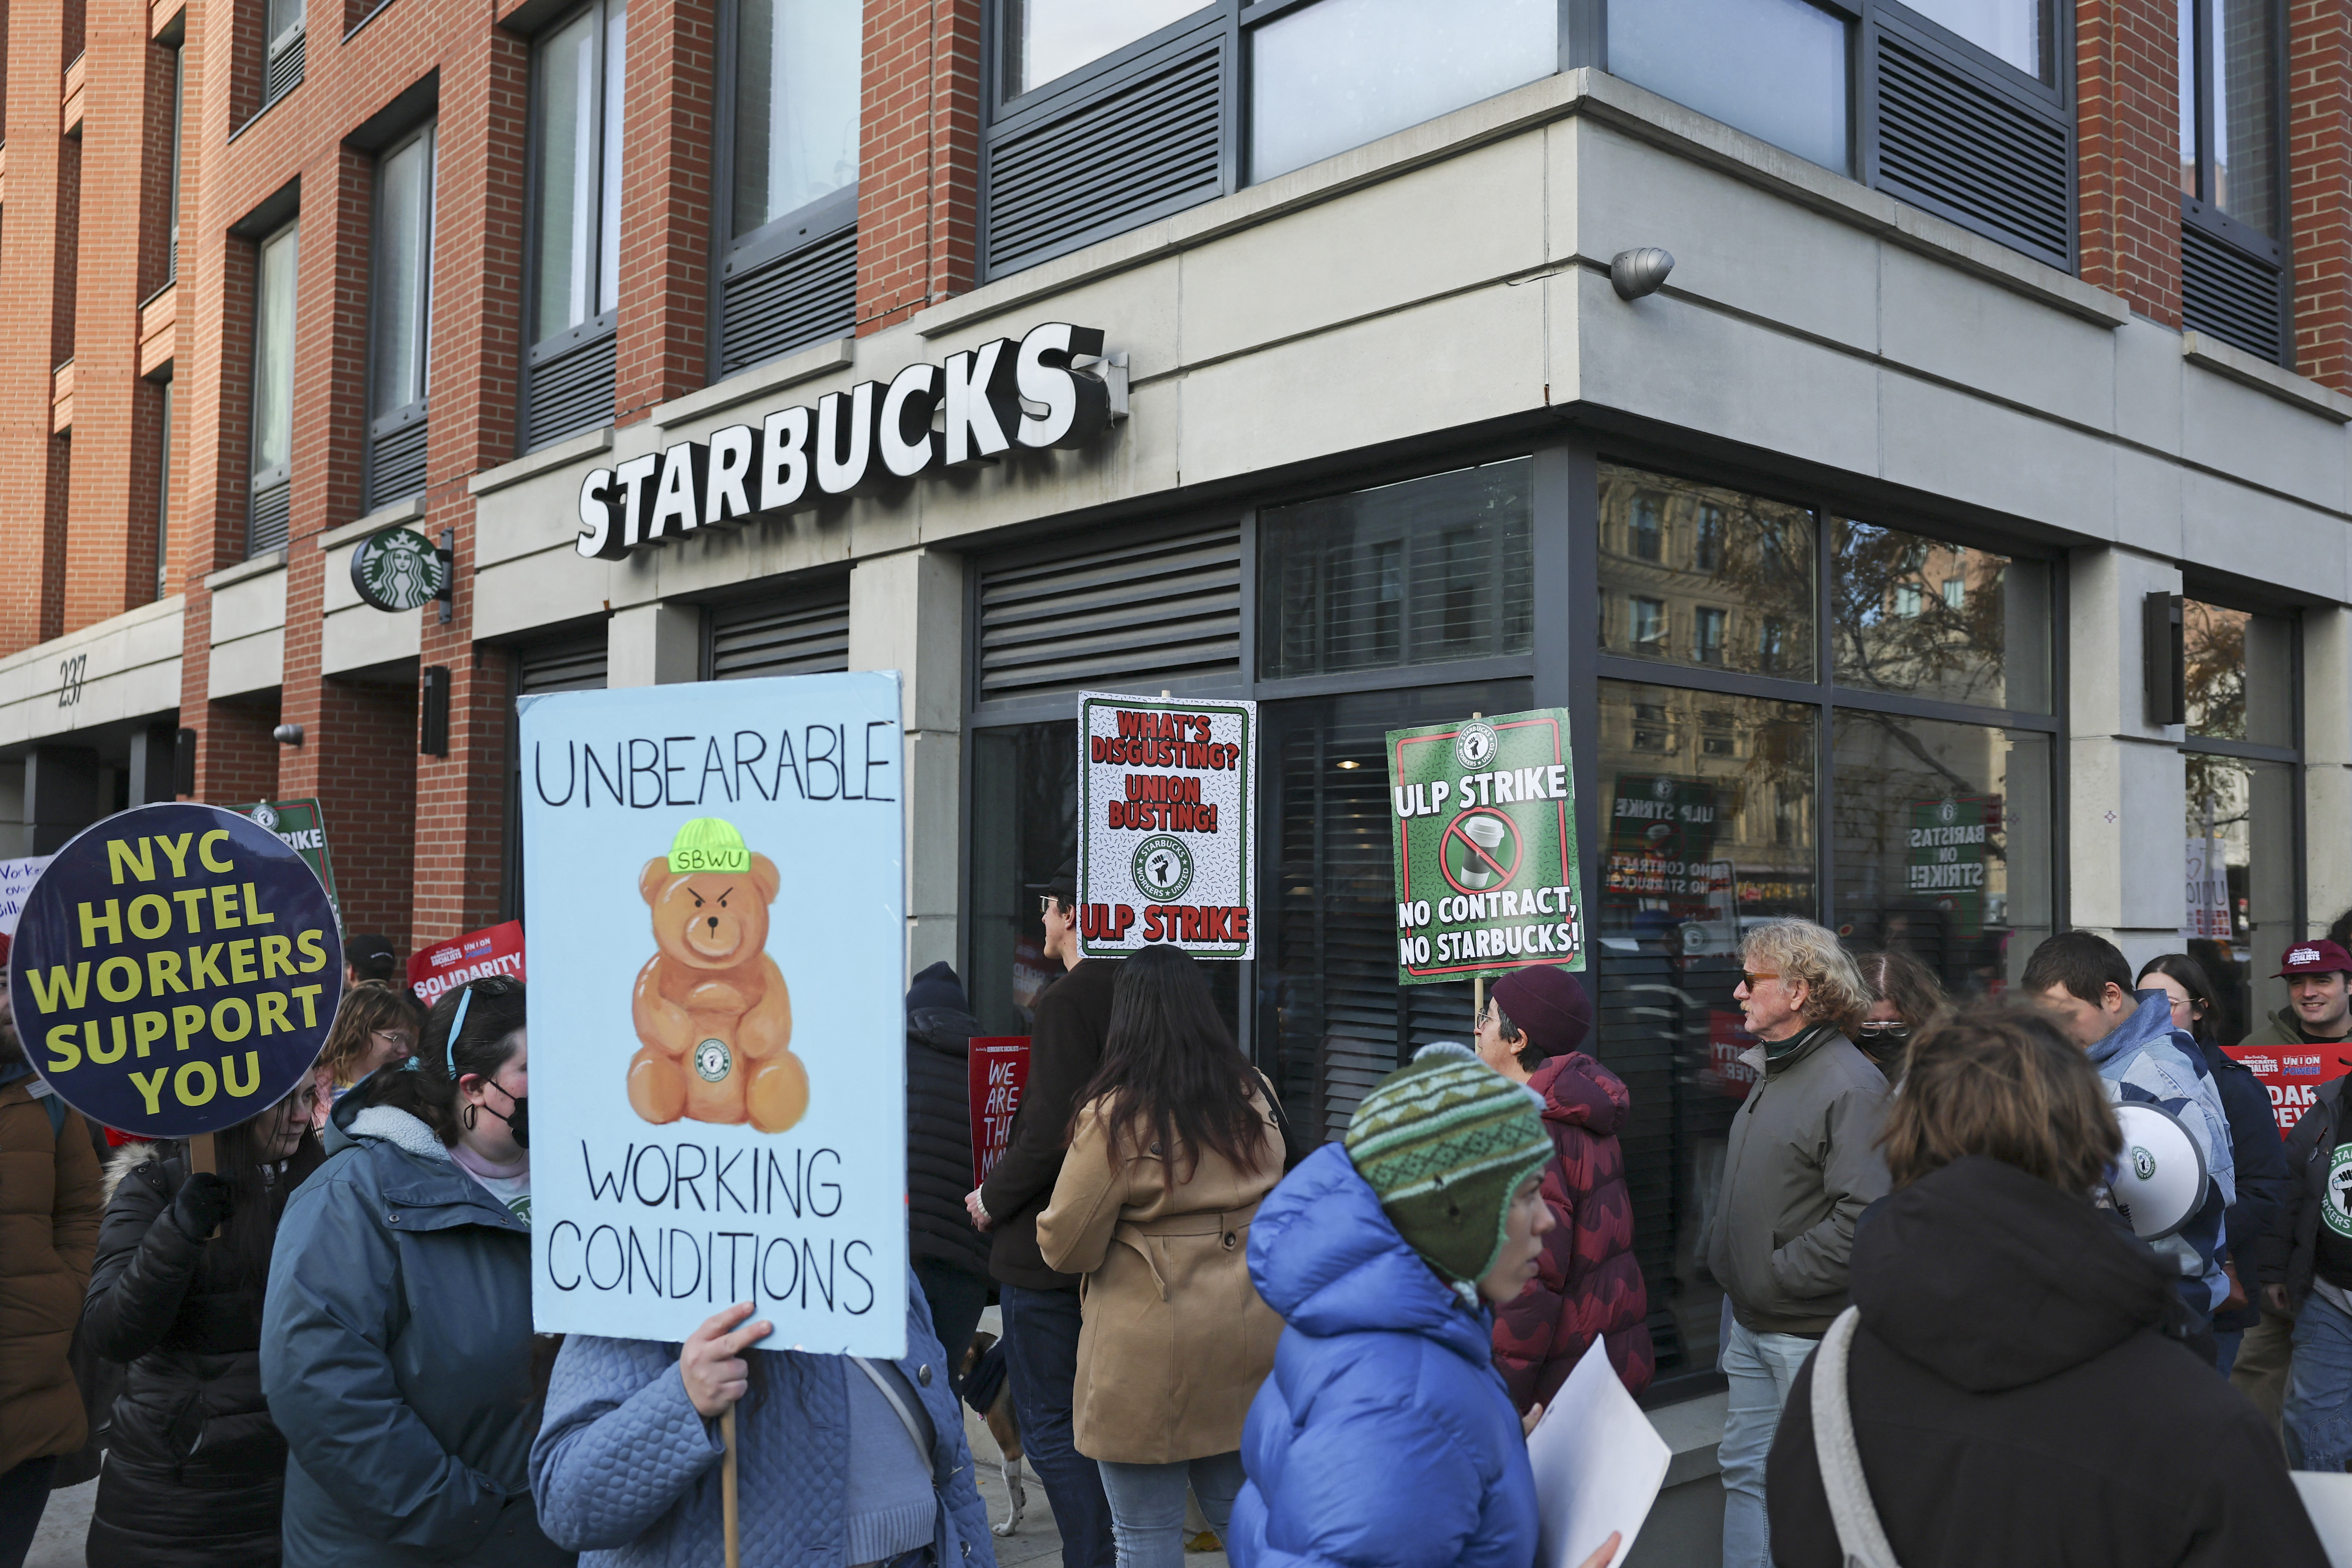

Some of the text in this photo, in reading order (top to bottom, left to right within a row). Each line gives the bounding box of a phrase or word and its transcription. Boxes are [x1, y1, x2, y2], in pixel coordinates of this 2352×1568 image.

[575, 322, 1079, 558] STARBUCKS
[59, 654, 86, 707] 237
[1116, 711, 1211, 742] WHAT'S
[1461, 726, 1491, 740] STARBUCKS
[535, 720, 895, 808] UNBEARABLE
[1091, 736, 1240, 771] DISGUSTING?
[1459, 743, 1495, 766] WORKERS UNITED
[1125, 774, 1200, 804] UNION
[1394, 764, 1568, 818] ULP STRIKE
[1109, 800, 1217, 833] BUSTING!
[107, 830, 234, 885] NYC
[678, 850, 742, 869] SBWU
[1141, 840, 1185, 858] STARBUCKS
[1137, 867, 1189, 897] WORKERS UNITED
[77, 882, 274, 948] HOTEL
[1081, 903, 1249, 943] ULP STRIKE
[1398, 886, 1576, 929] NO CONTRACT,
[464, 937, 491, 951] UNION
[1400, 922, 1580, 965] NO STARBUCKS!
[25, 929, 327, 1014] WORKERS
[413, 952, 521, 999] SOLIDARITY
[46, 984, 322, 1072] SUPPORT
[989, 1059, 1017, 1086] WE
[2283, 1056, 2320, 1065] UNION
[128, 1051, 261, 1115] YOU
[985, 1086, 1019, 1115] ARE
[582, 1139, 842, 1218] WORKING
[548, 1220, 874, 1314] CONDITIONS
